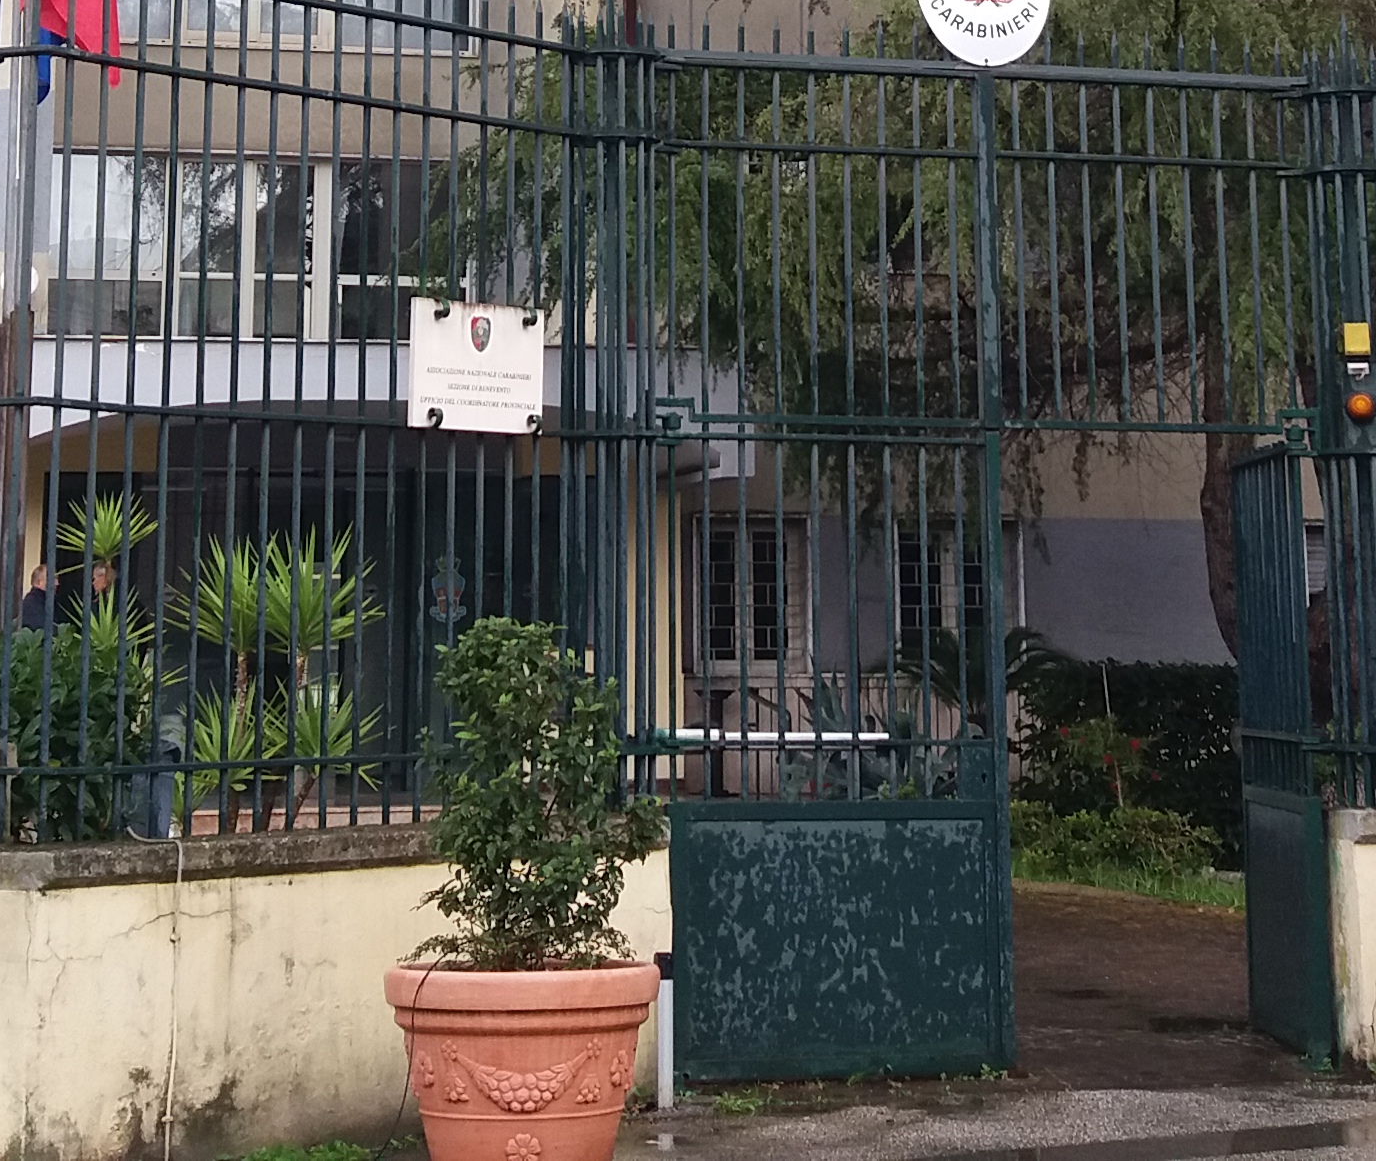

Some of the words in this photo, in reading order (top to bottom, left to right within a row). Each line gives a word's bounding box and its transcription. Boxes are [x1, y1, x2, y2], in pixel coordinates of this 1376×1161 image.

[426, 366, 466, 375] ASSOCIAZIONE
[466, 369, 497, 378] NAZIONALE
[497, 371, 532, 380] CARABINIERI
[479, 385, 511, 393] BENEVENTO
[419, 395, 444, 404] UFFICIO
[444, 397, 456, 405] DEL
[456, 398, 500, 408] COORDINATORE
[500, 401, 536, 410] PROVINCIALE
